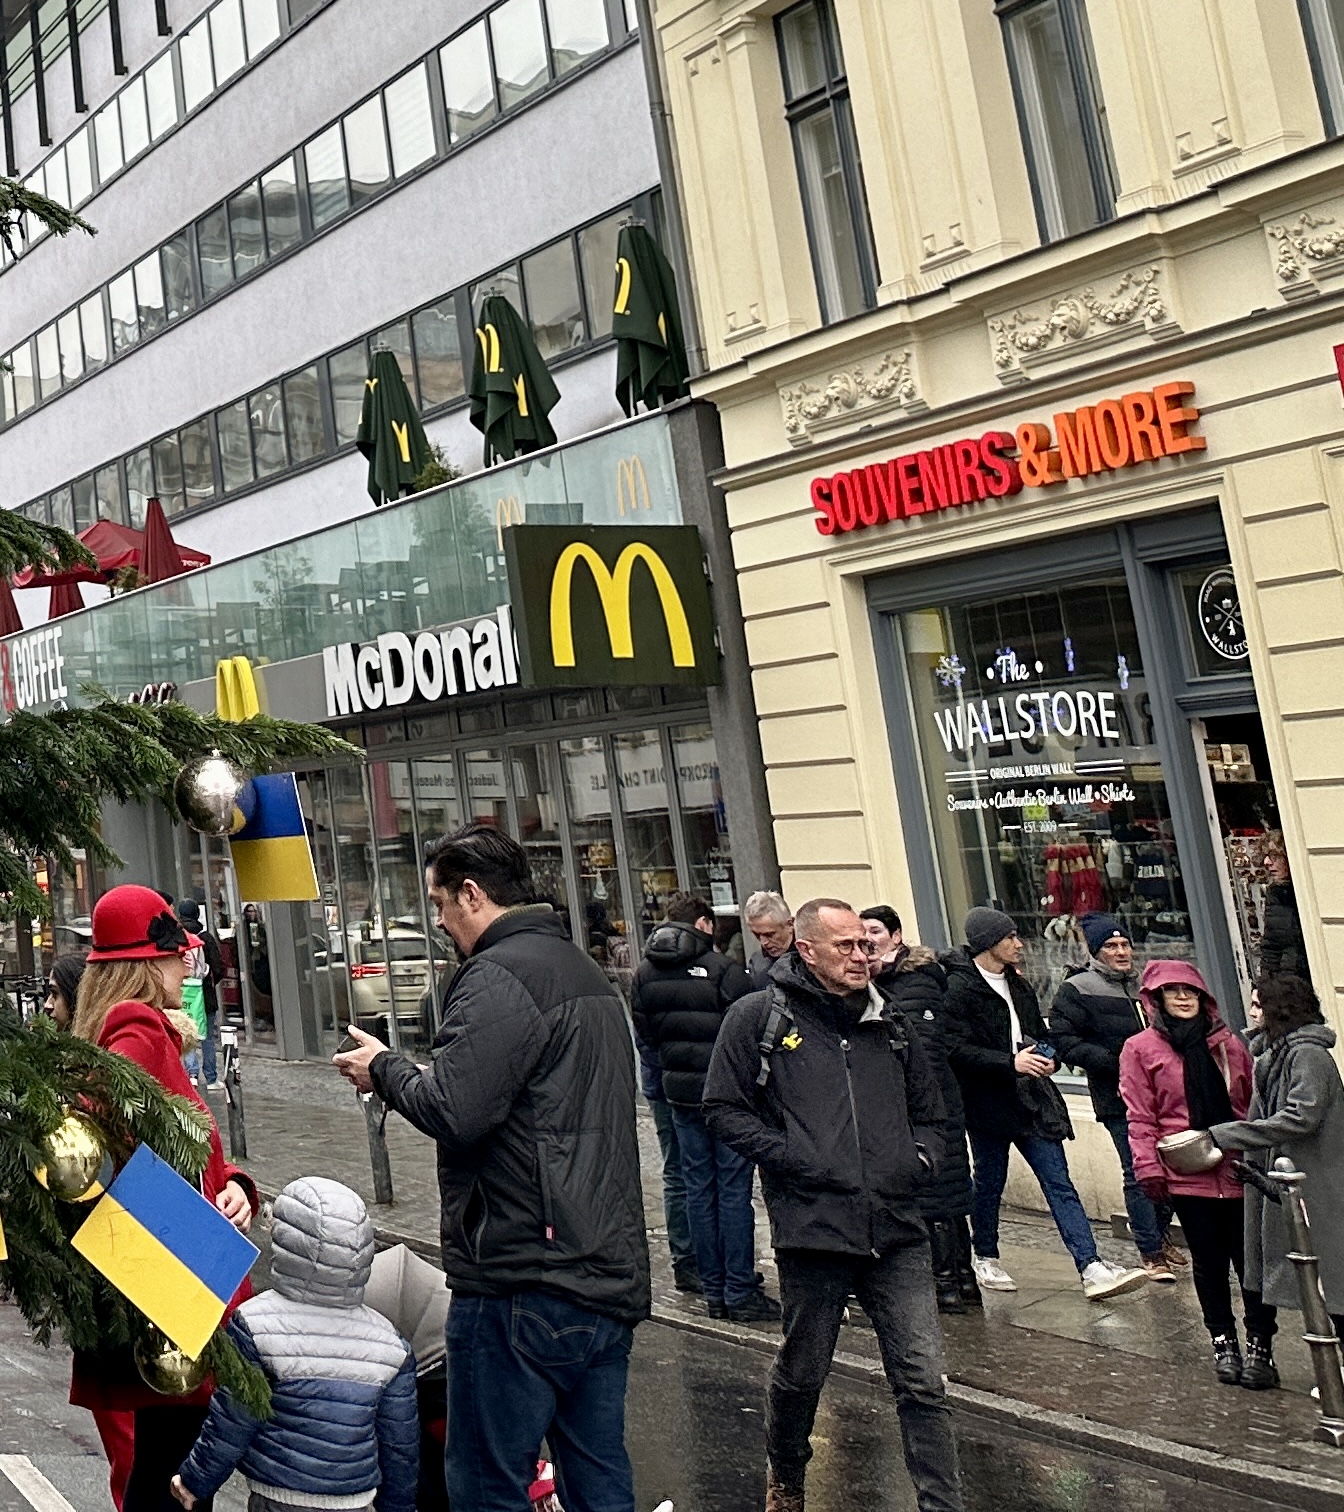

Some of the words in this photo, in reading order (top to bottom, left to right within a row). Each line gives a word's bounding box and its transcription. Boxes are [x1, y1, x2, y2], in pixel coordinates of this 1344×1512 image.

[810, 431, 1024, 535] SOUVENIRS
[1015, 422, 1067, 487] &
[1053, 381, 1208, 477] MORE
[0, 642, 16, 713] &
[12, 626, 68, 709] COFFEE
[323, 604, 521, 717] McDonal
[996, 651, 1030, 683] The
[934, 691, 1120, 753] WALLSTORE
[990, 766, 1024, 780] ORIGINAL
[1025, 764, 1050, 777] BERLIN
[1051, 762, 1074, 775] WALL
[994, 789, 1035, 809] Authentic
[1036, 787, 1066, 807] Berlin
[1068, 785, 1094, 804] Wall
[1101, 782, 1136, 804] Shirts
